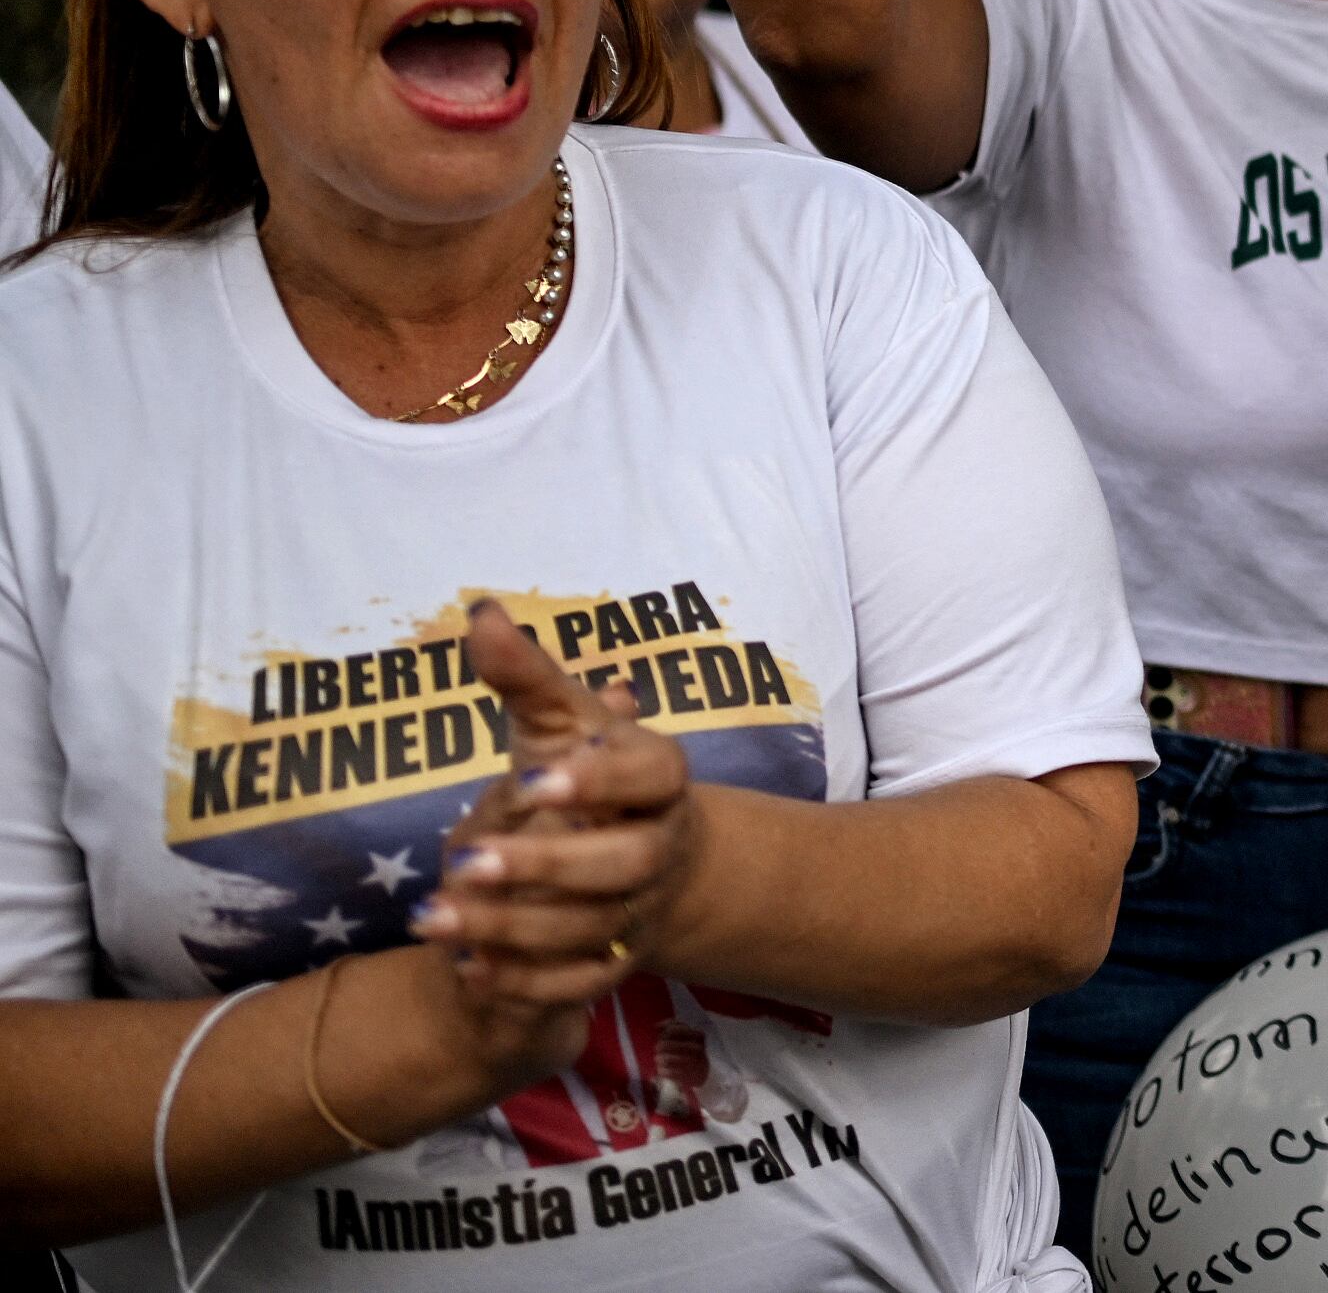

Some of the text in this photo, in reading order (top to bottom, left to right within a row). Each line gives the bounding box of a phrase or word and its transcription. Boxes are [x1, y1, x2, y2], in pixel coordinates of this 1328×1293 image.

[251, 580, 721, 727] LIBERT PARA
[190, 640, 792, 821] KENNEDY JEDA
[587, 1119, 795, 1229] General
